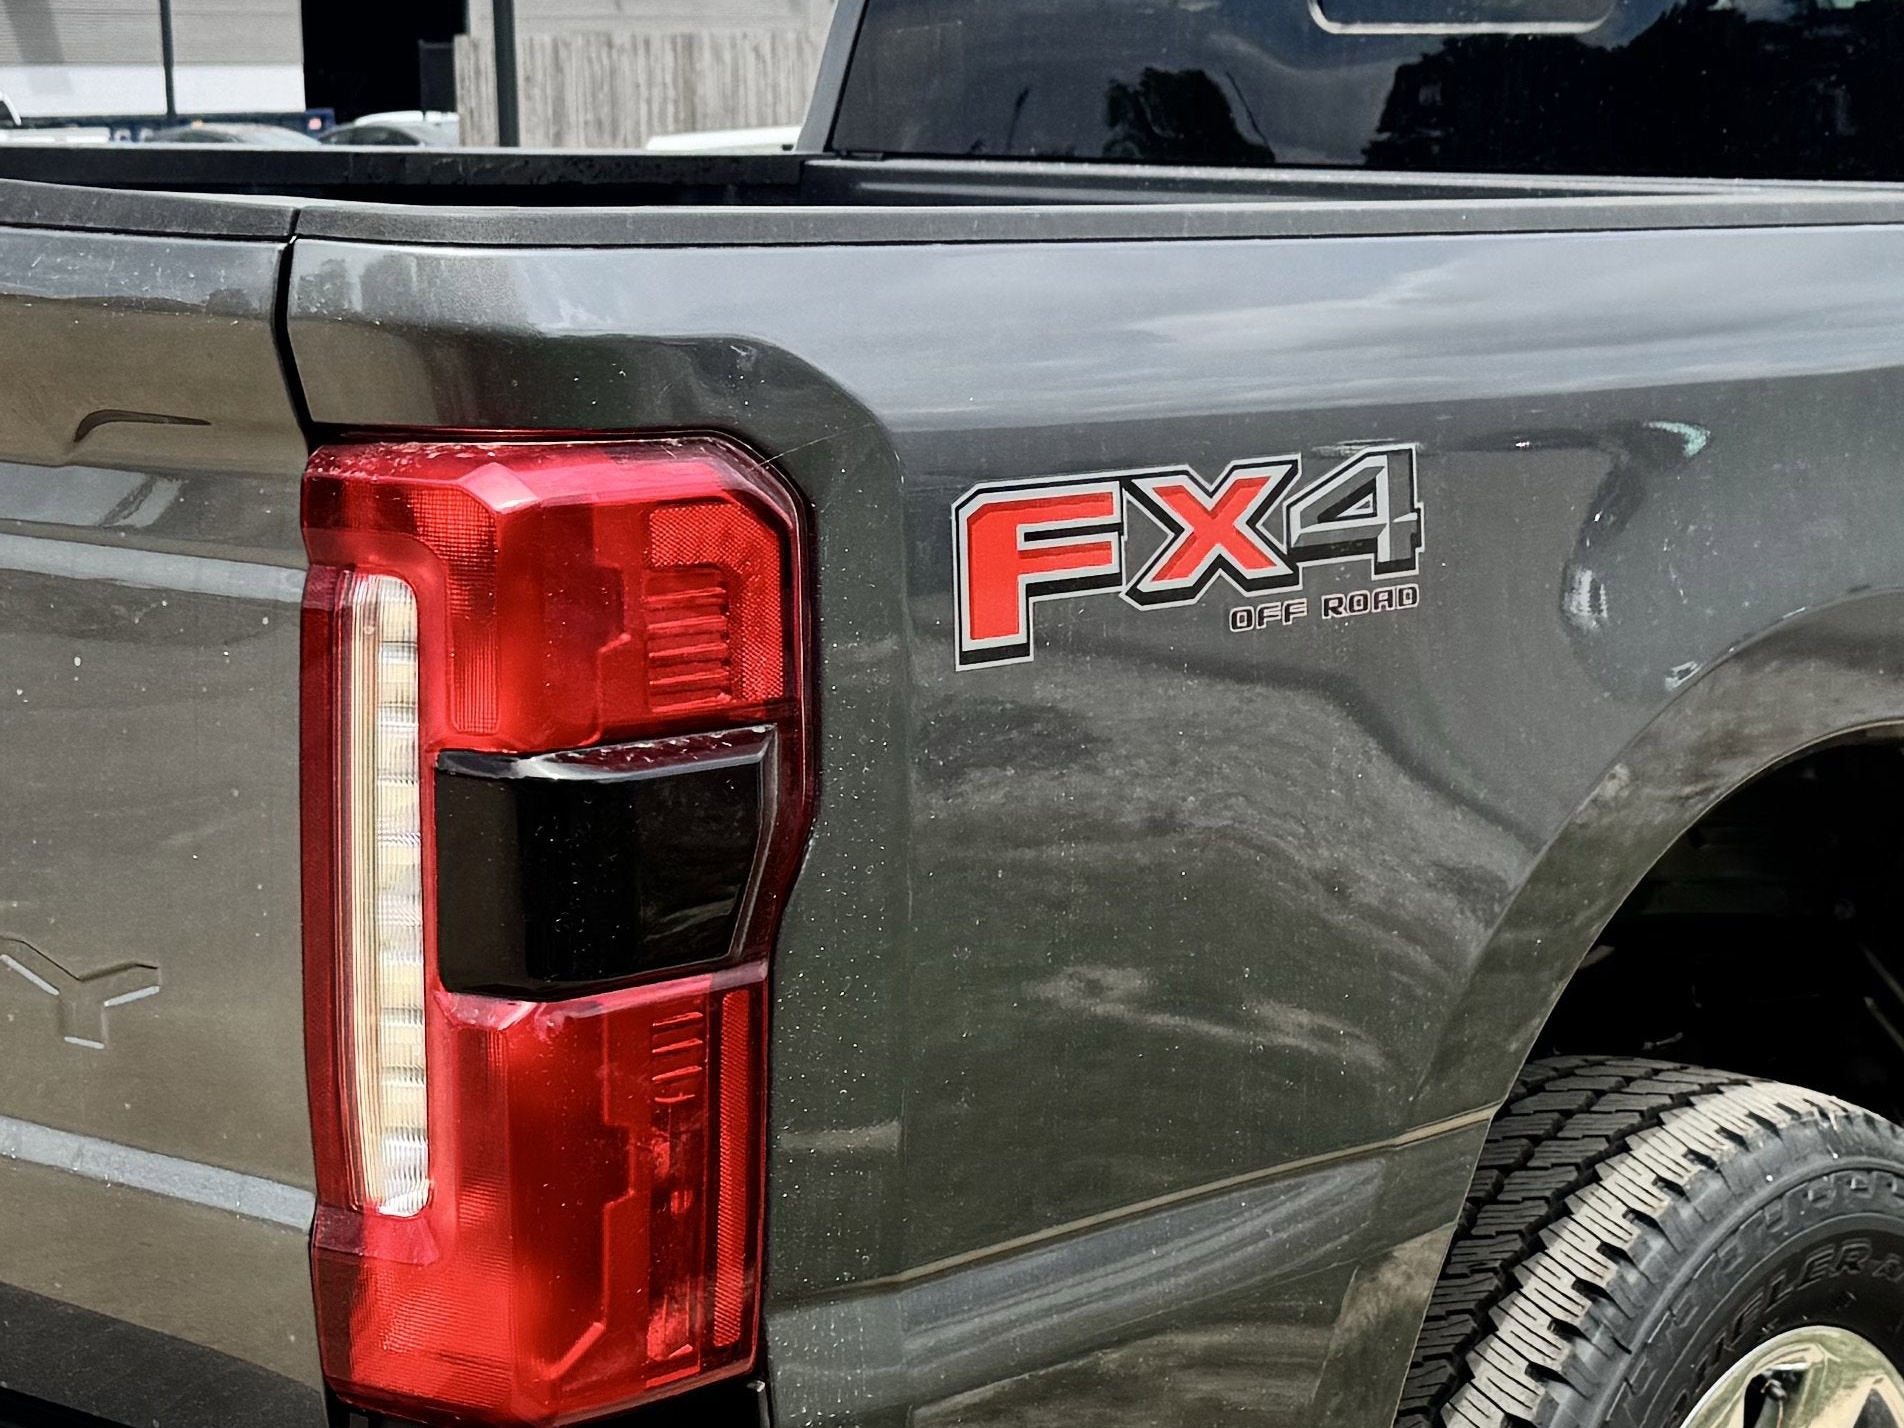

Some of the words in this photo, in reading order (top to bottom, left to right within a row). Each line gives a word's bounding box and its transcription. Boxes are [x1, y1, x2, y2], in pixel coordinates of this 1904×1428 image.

[951, 443, 1425, 671] FX4
[1230, 598, 1309, 633] OFF
[1322, 583, 1420, 621] ROAD
